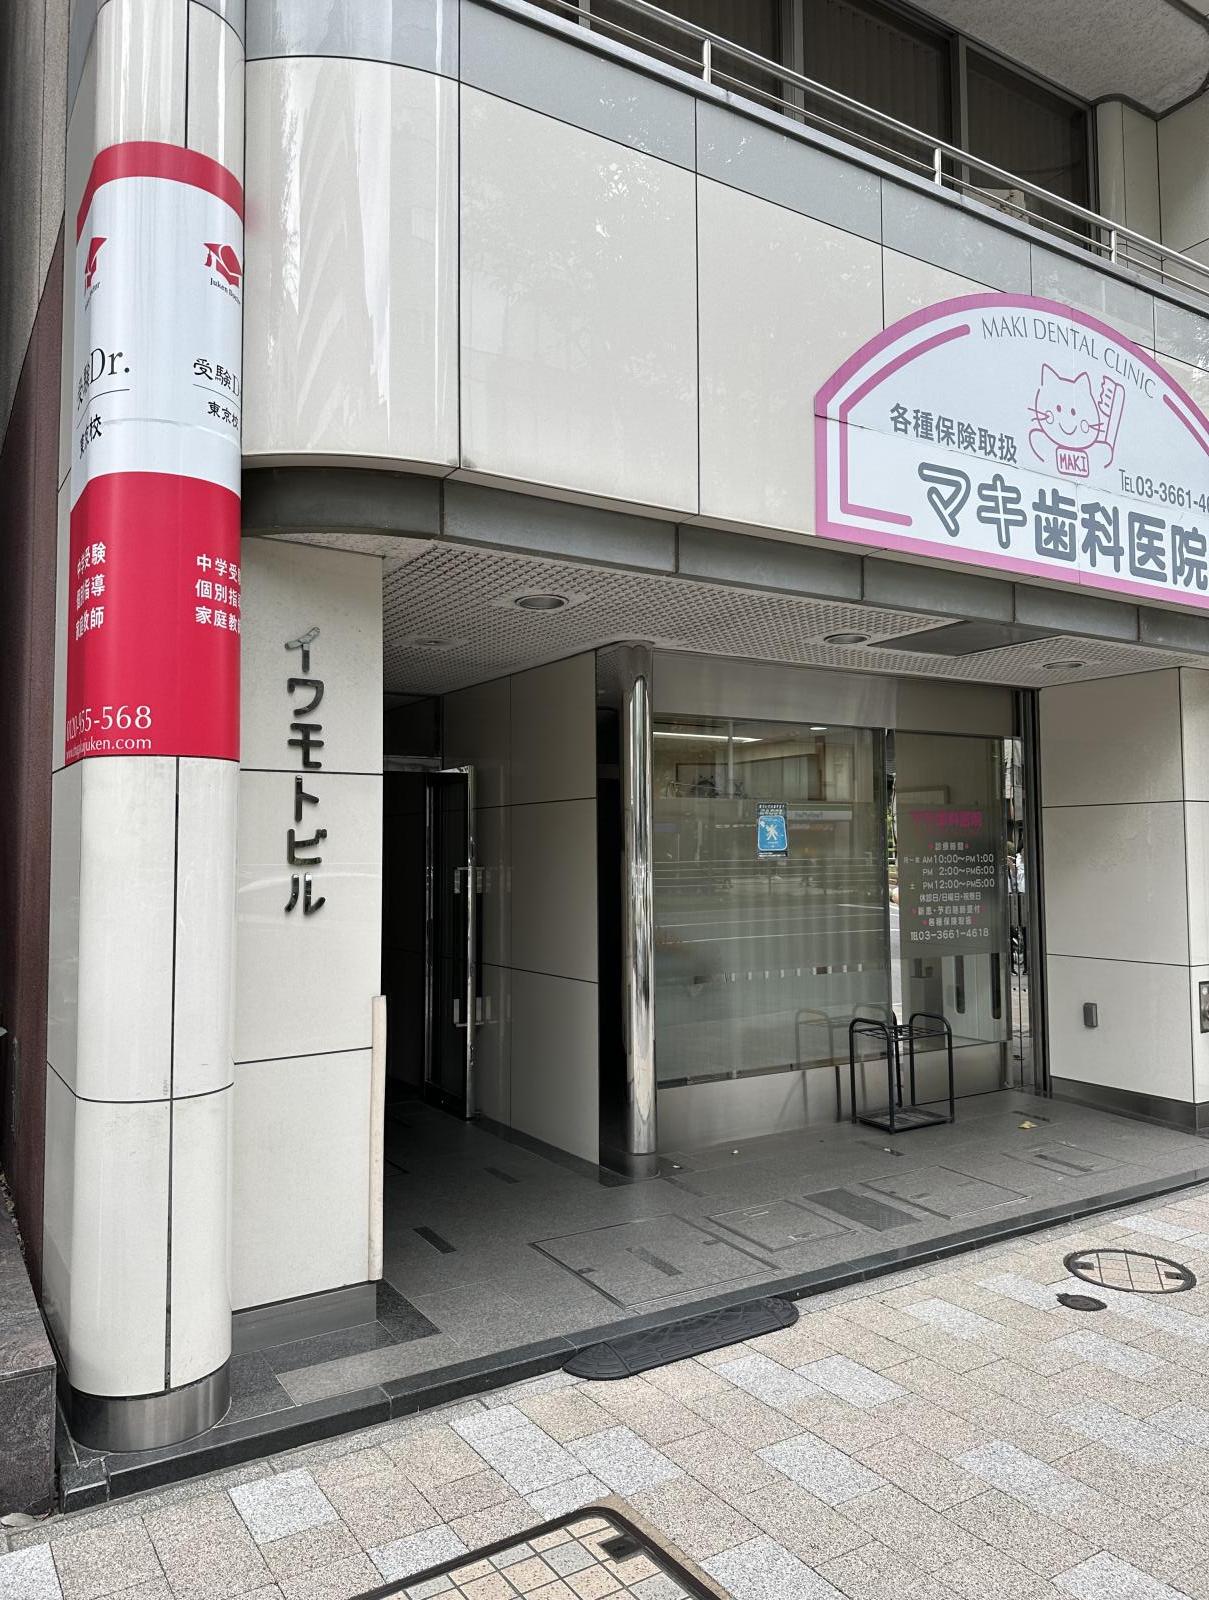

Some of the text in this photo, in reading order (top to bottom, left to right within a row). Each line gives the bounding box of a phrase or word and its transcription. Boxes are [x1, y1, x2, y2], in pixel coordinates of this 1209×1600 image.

[982, 316, 1156, 399] MAKI DENTAL CLINIC
[207, 401, 239, 431] 東京校
[889, 403, 1018, 465] 各種保険取扱
[1059, 453, 1088, 473] MAKI
[918, 461, 1209, 591] マキ歯科医院
[284, 626, 328, 915] イワモトビル
